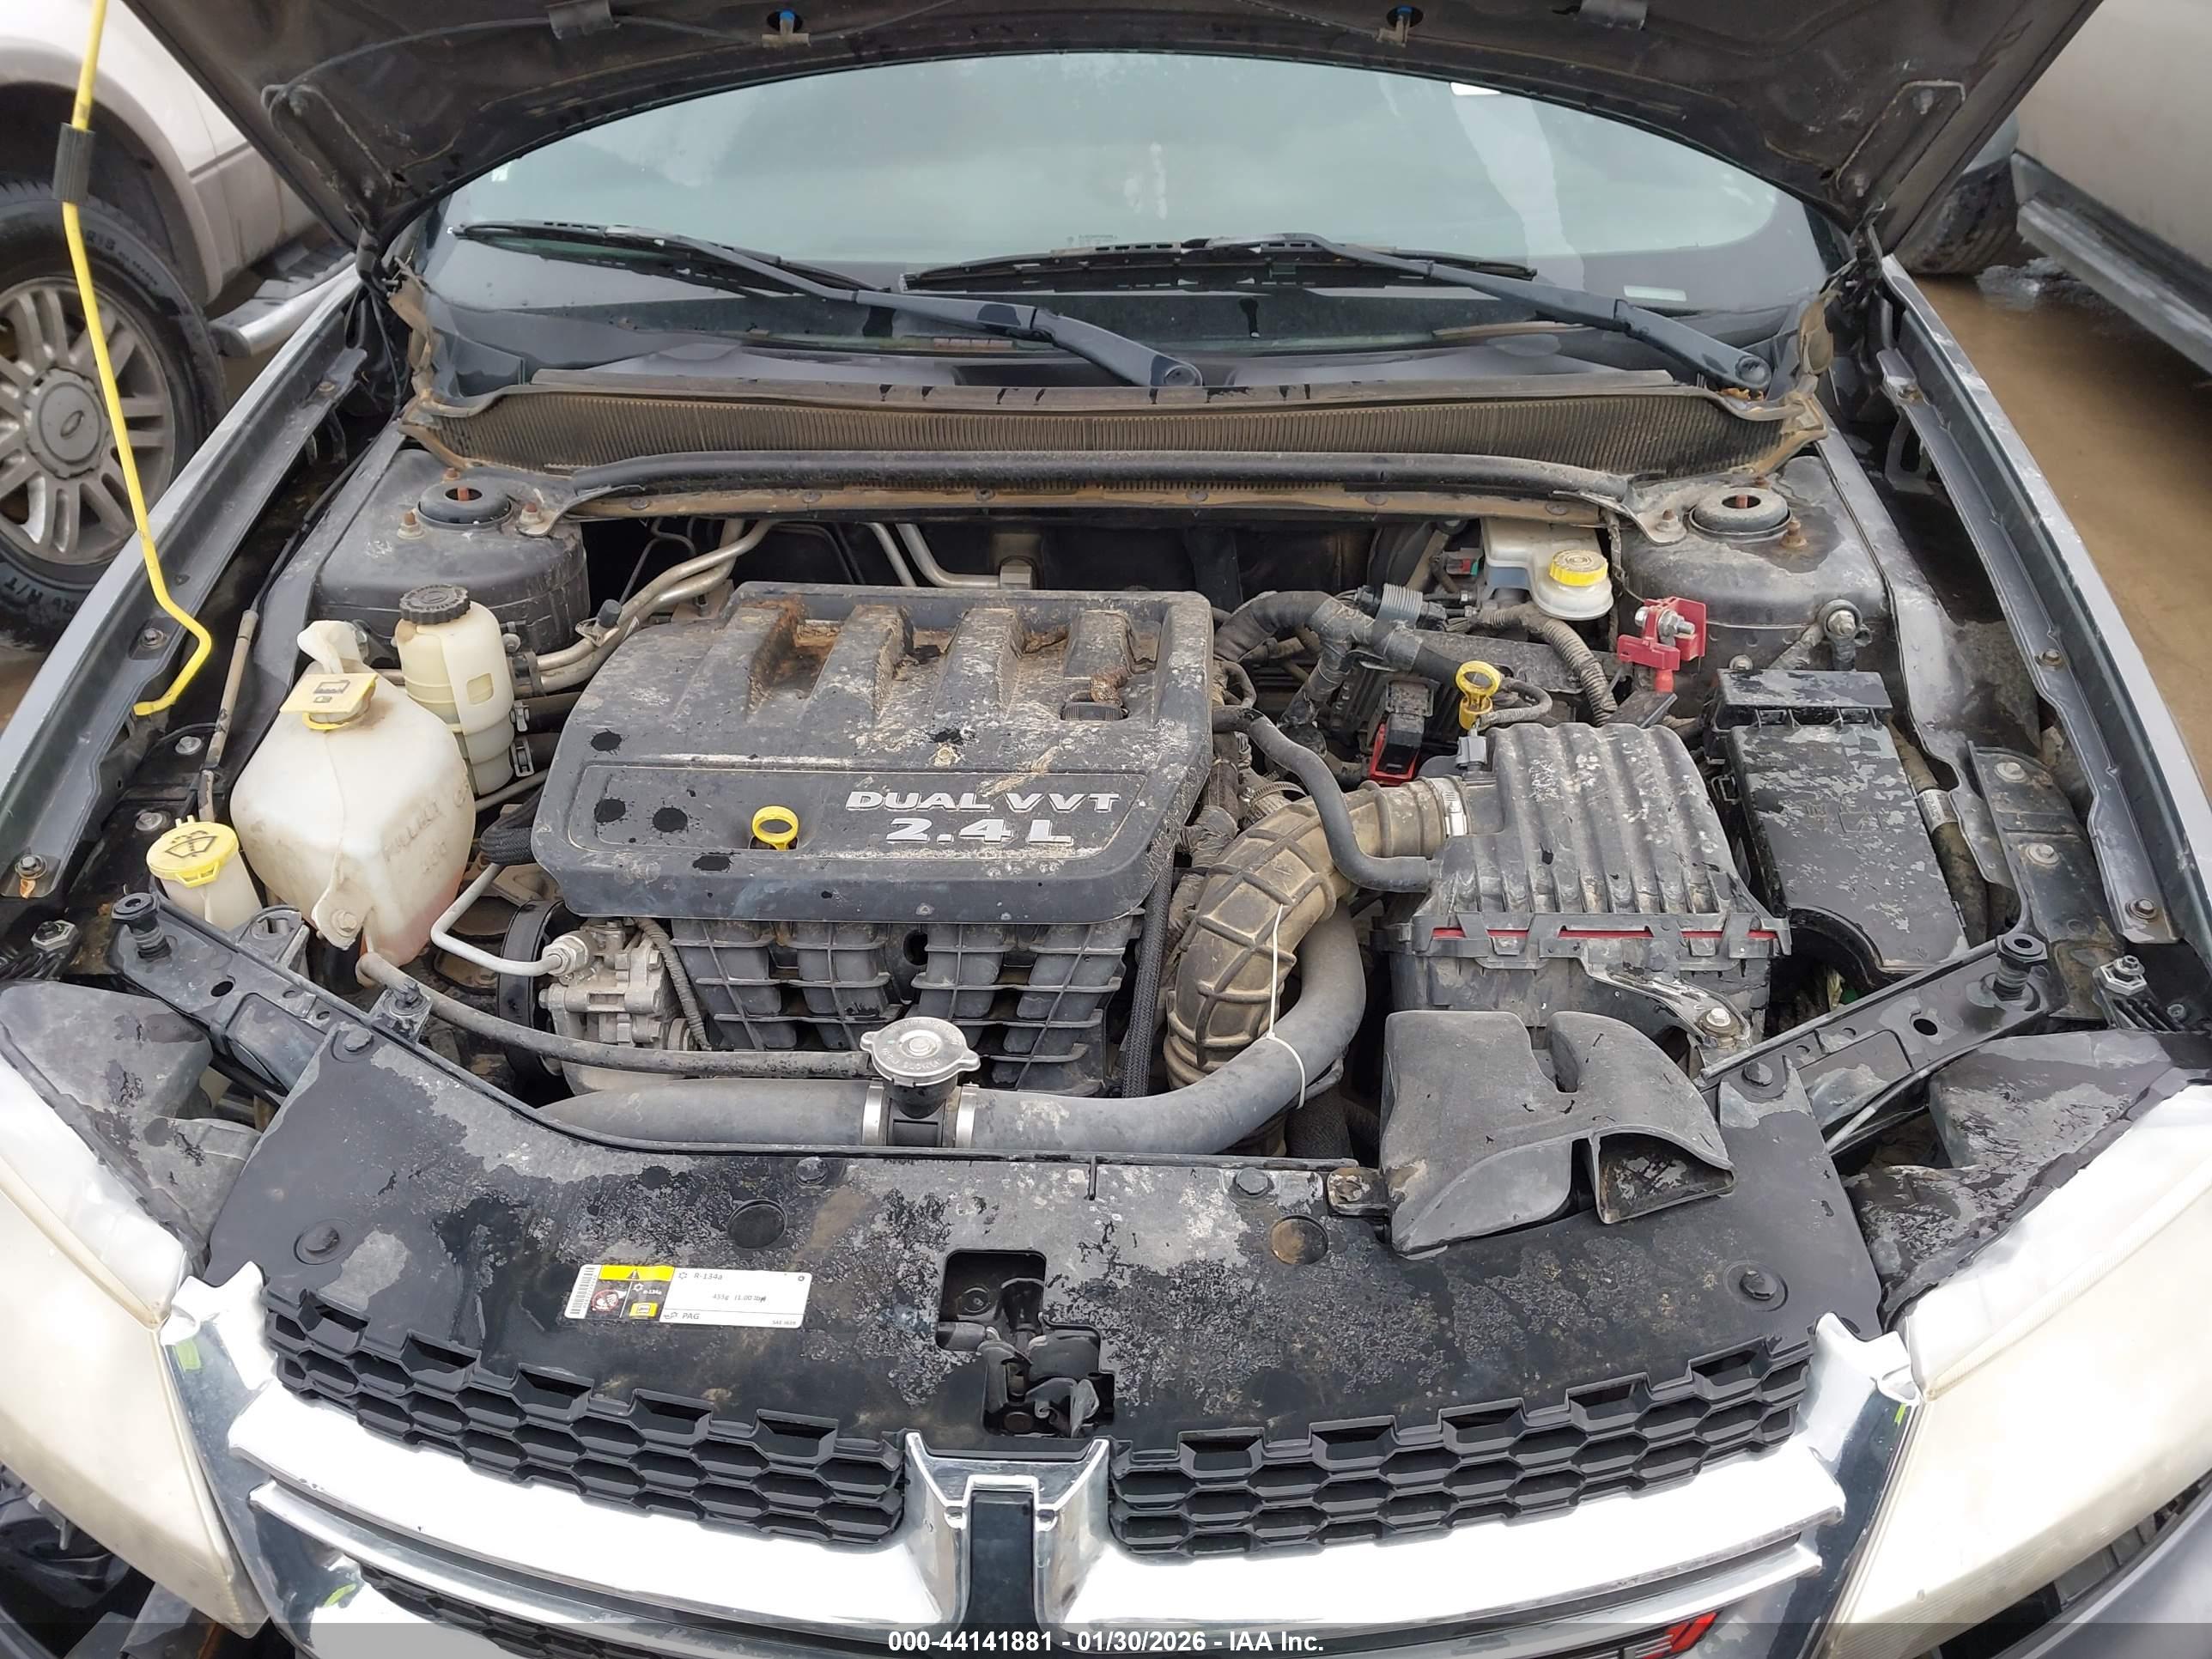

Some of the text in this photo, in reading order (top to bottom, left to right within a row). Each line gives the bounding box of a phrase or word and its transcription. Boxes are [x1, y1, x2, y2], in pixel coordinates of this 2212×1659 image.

[846, 790, 1120, 812] DUAL VVT
[693, 1272, 724, 1281] R-134a
[682, 1312, 701, 1321] PAG
